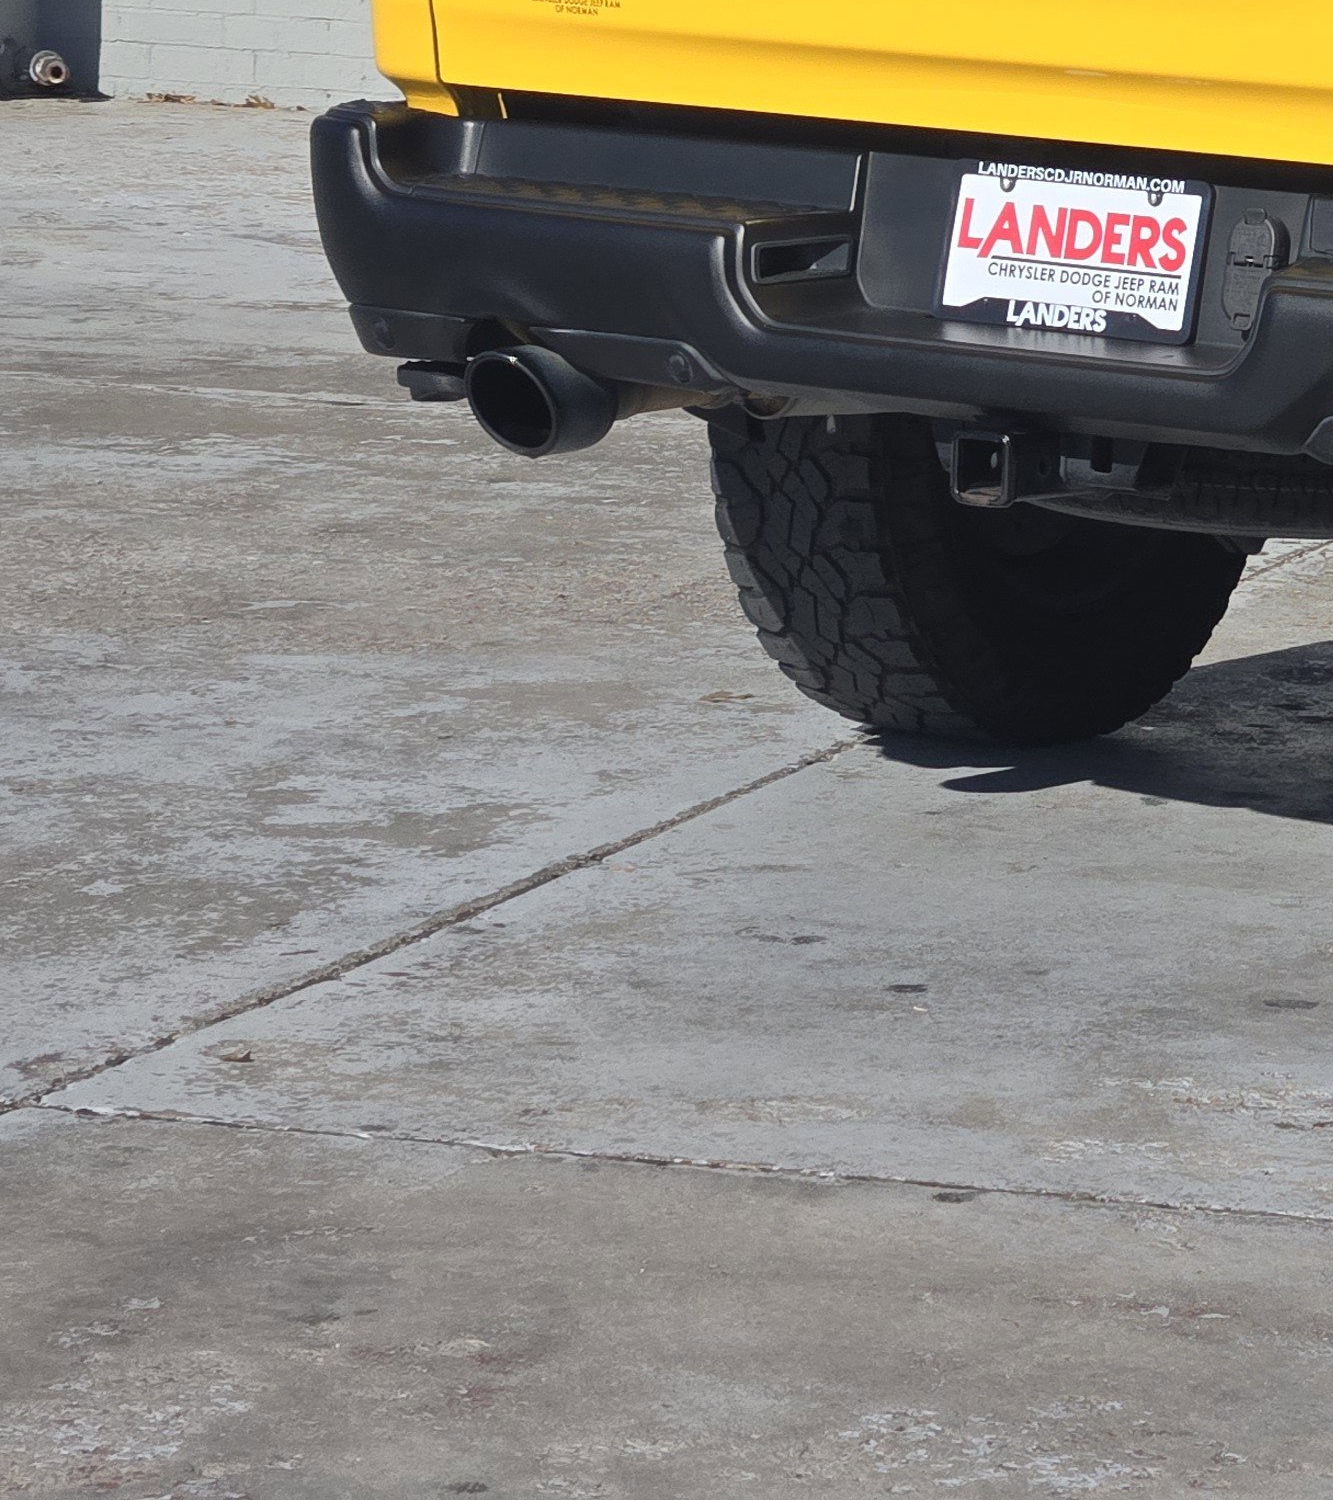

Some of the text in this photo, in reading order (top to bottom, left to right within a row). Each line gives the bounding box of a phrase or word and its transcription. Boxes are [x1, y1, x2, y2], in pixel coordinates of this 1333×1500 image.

[566, 6, 599, 16] NORMAN
[978, 161, 1186, 194] LANDERSCDJRNORMAN.COM
[956, 197, 1188, 273] LANDERS
[987, 261, 1180, 296] CHRYSLER DODGE JEEP RAM
[1006, 299, 1107, 333] LANDERS
[1091, 289, 1179, 312] OF NORMAN
